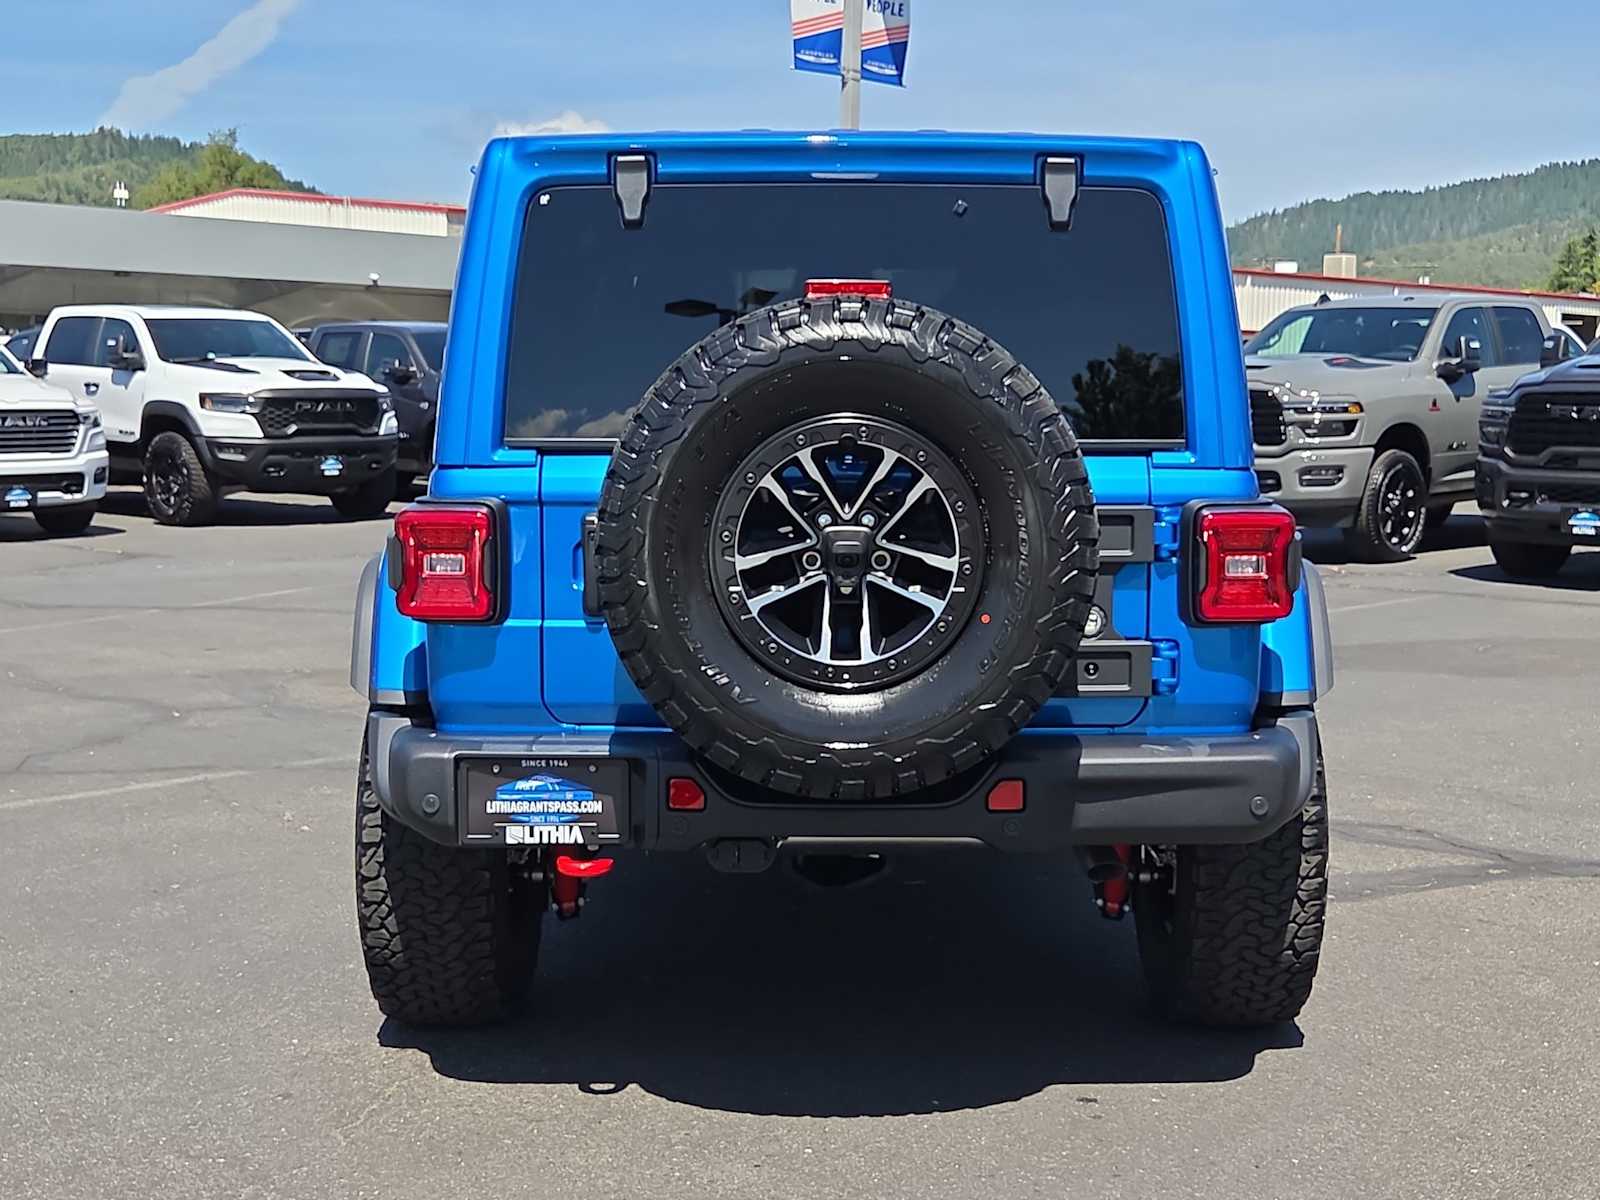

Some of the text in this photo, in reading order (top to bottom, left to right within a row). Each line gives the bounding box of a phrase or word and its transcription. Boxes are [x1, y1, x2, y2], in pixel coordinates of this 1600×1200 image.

[867, 0, 904, 17] PEOPLE
[521, 759, 569, 768] SINCE 1946
[486, 800, 602, 813] LITHIAGRANTSPASS.COM
[523, 826, 584, 844] LITHIA
